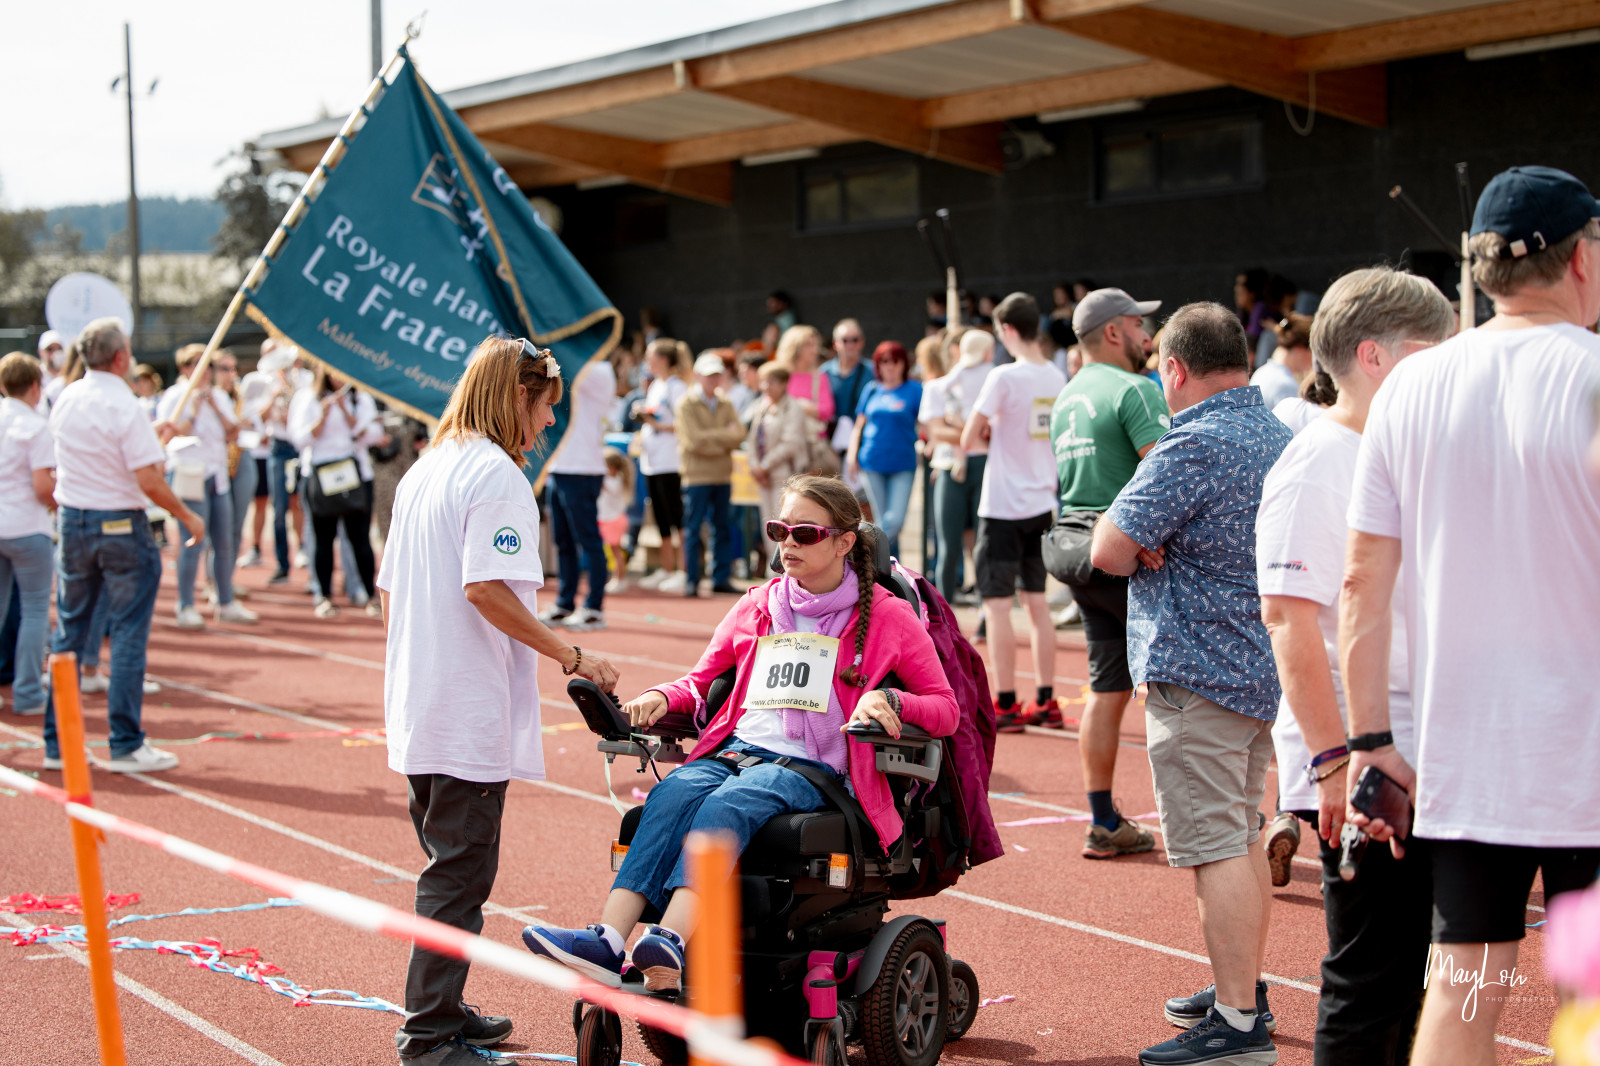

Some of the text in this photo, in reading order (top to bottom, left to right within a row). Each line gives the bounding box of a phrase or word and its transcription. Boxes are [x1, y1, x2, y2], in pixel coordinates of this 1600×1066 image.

[302, 244, 351, 303] La
[326, 214, 429, 298] Royale
[316, 317, 394, 371] Malmedy
[493, 534, 518, 547] MB
[766, 662, 810, 689] 890
